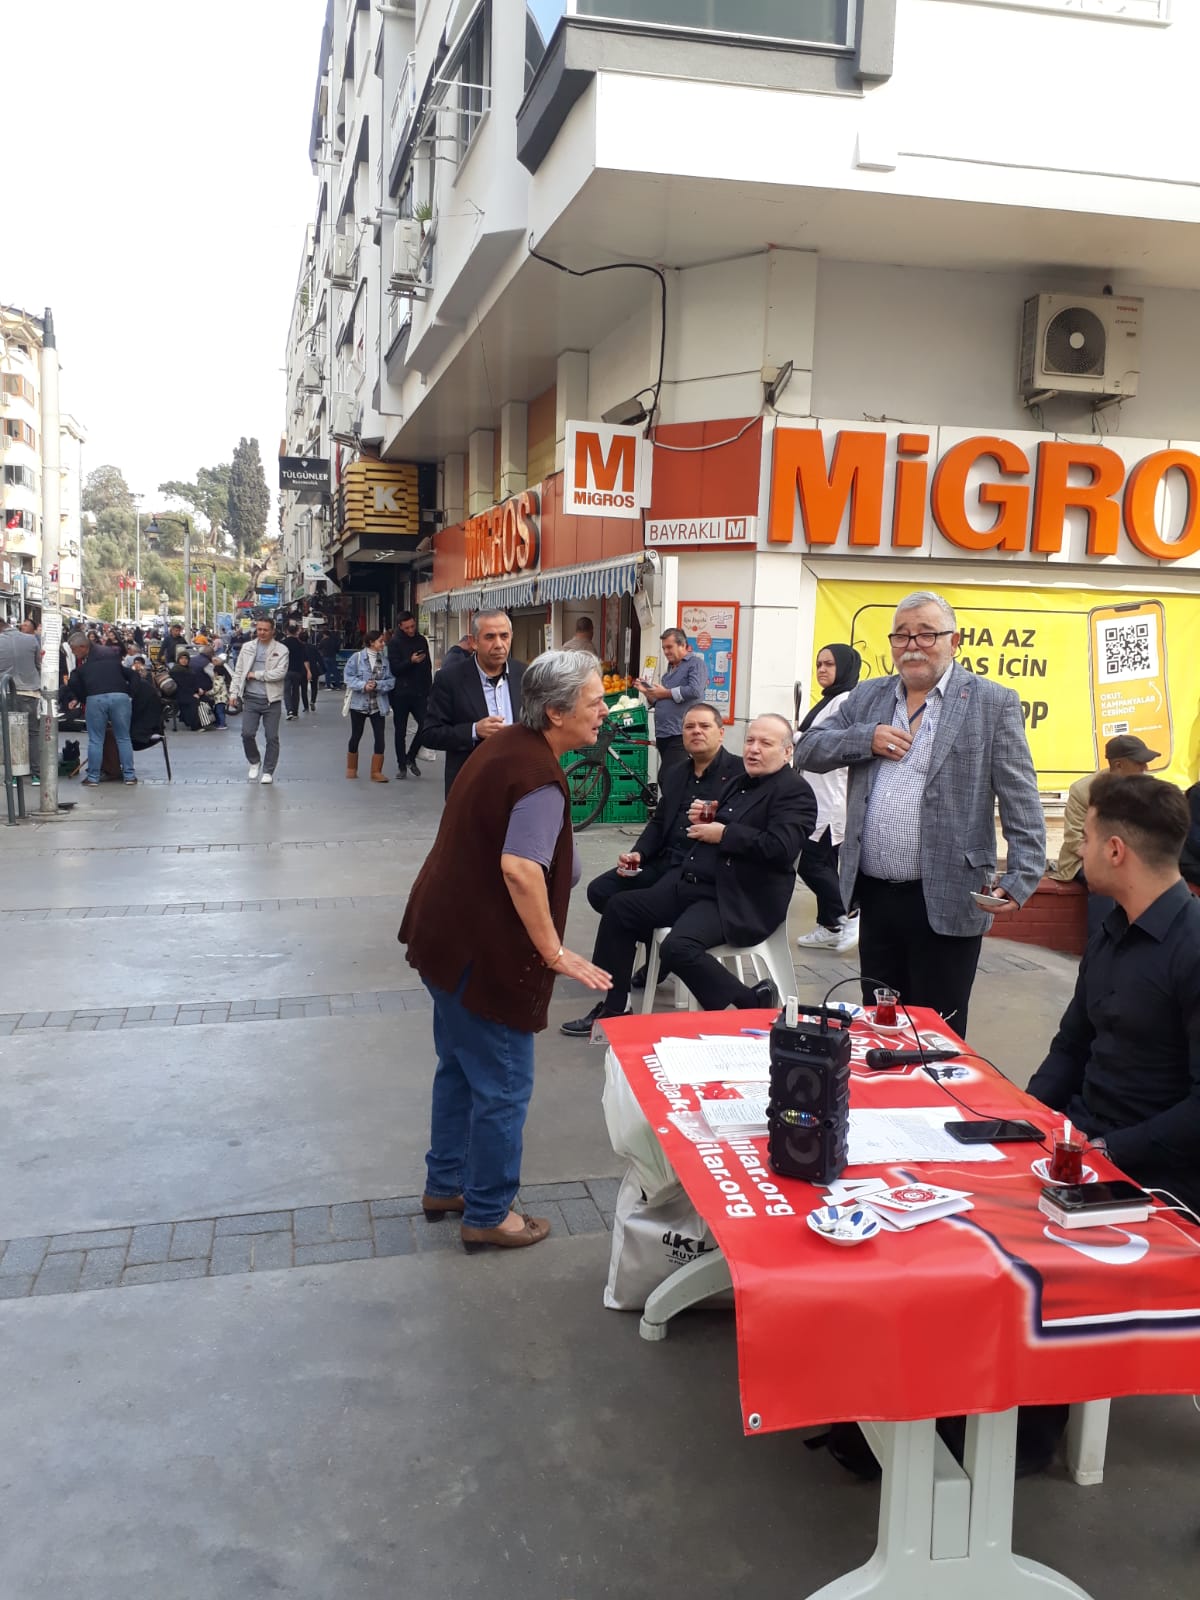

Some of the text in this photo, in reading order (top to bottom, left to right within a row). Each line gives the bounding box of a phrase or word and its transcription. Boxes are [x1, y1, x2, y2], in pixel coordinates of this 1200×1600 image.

[574, 431, 636, 492] M
[373, 486, 399, 512] K
[769, 427, 1200, 560] MiGRO
[650, 522, 720, 541] BAYRAKLI
[960, 628, 1036, 648] HA AZ
[960, 653, 1047, 679] AS İÇİN
[672, 1249, 698, 1261] KUY
